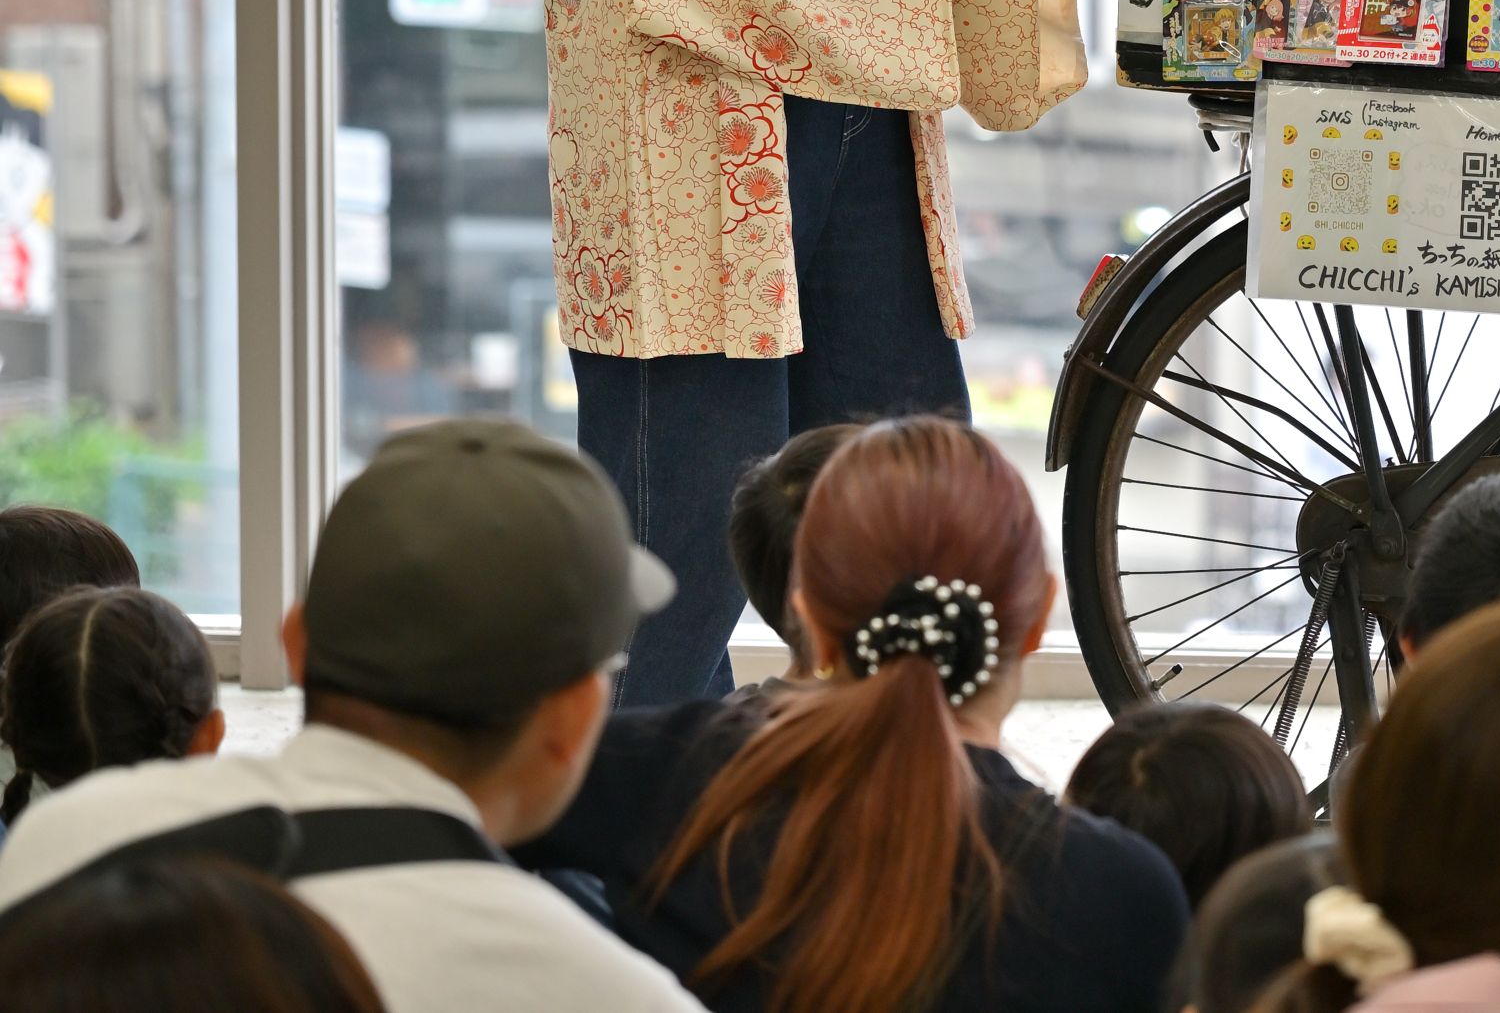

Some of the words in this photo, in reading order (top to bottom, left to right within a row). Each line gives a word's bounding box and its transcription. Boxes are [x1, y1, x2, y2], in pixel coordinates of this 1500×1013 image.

[1340, 49, 1369, 58] No.30
[1316, 110, 1353, 125] SNS
[1369, 99, 1416, 115] Facebook
[1366, 114, 1421, 131] Instagram
[1298, 265, 1419, 297] CHICCHI's
